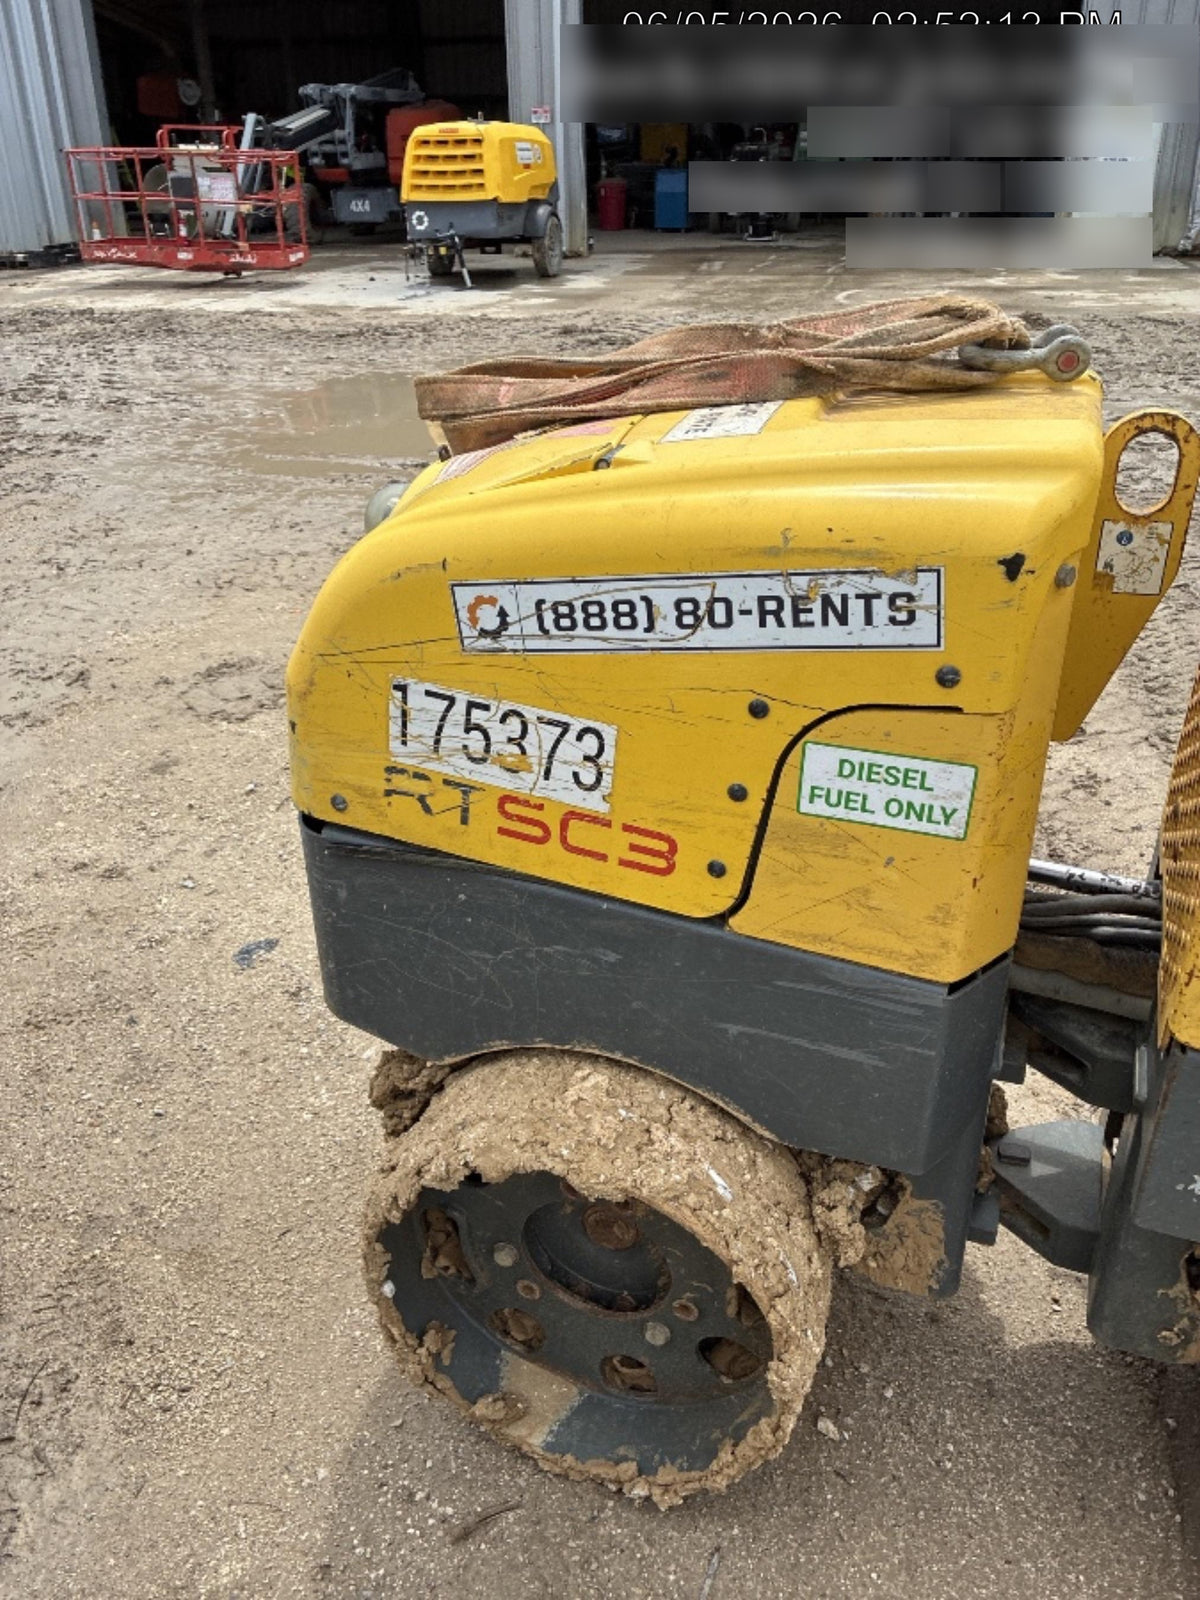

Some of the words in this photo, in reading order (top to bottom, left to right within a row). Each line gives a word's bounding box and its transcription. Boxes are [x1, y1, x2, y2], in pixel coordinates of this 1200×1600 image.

[536, 597, 656, 633] (888)
[674, 591, 917, 629] 80-RENTS
[392, 684, 606, 792] 175373
[837, 758, 934, 792] DIESEL
[808, 785, 875, 814] FUEL
[884, 797, 959, 826] ONLY
[497, 794, 678, 877] SC3
